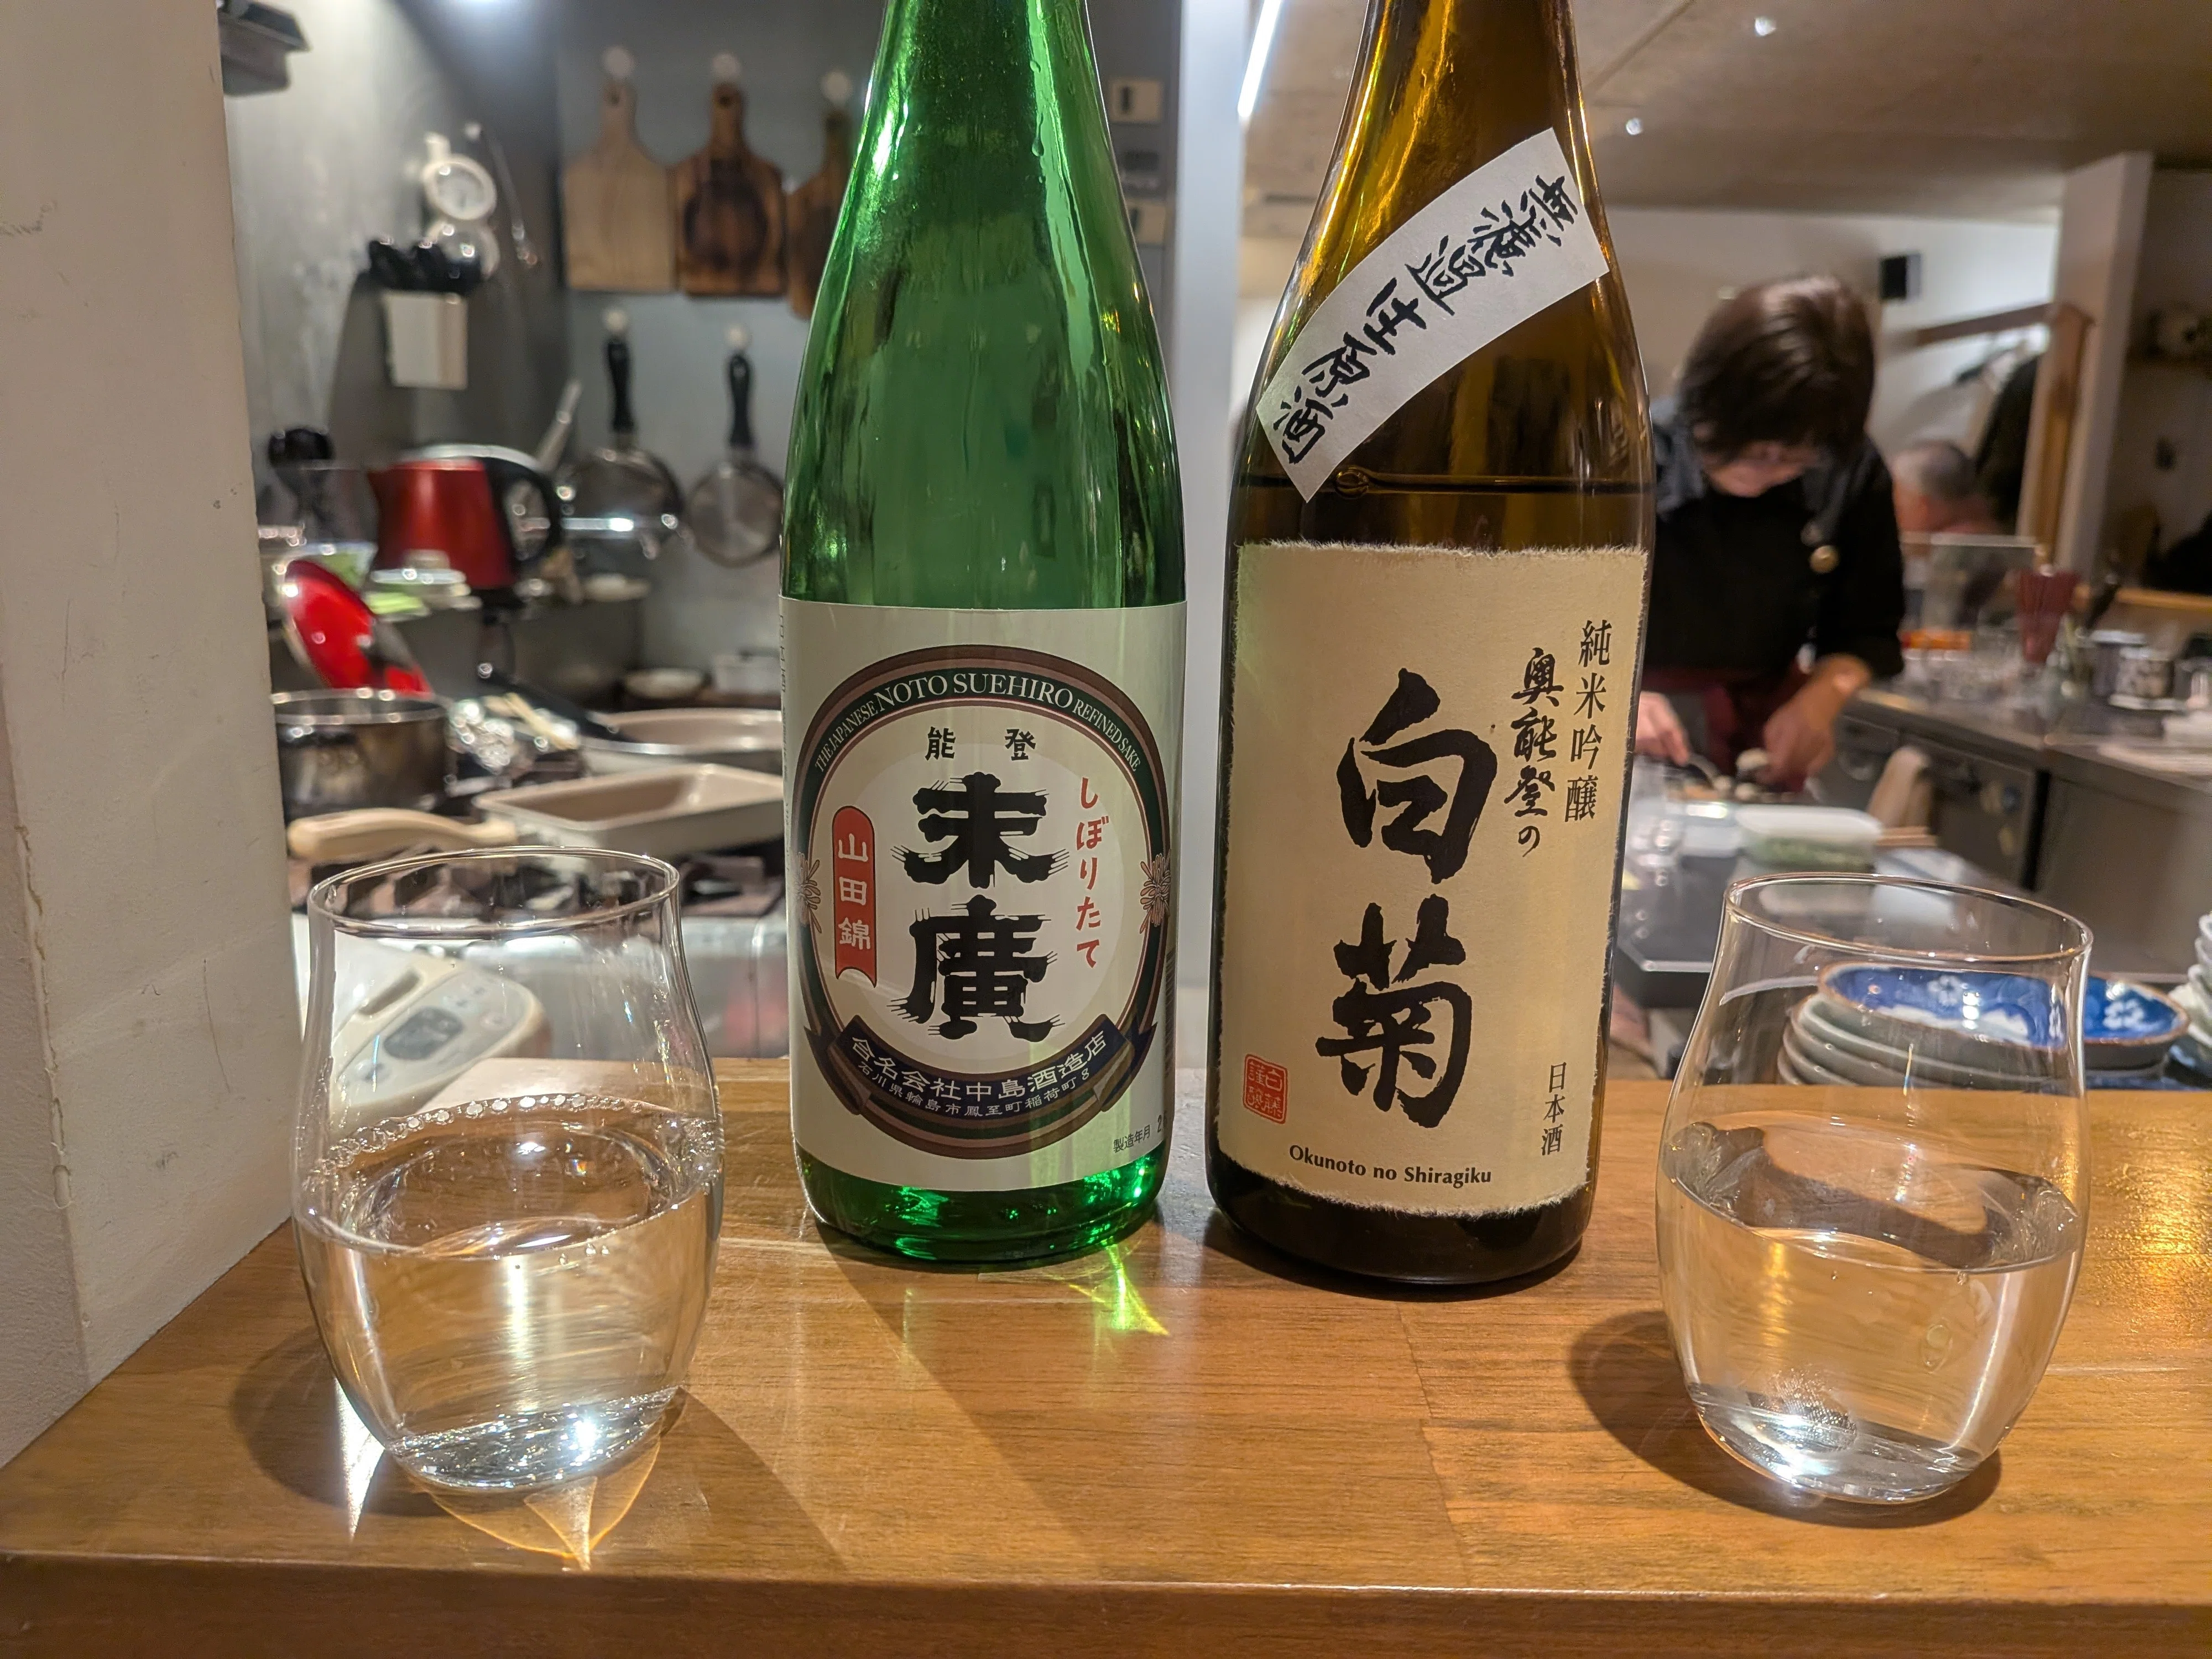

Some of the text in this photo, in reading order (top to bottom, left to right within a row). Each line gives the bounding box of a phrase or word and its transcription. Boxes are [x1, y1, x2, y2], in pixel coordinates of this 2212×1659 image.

[815, 745, 834, 773] THE
[828, 700, 879, 752] JAPANESE
[873, 675, 948, 712] NOTO
[953, 672, 1073, 709] SUEHIRO
[1072, 698, 1123, 744] REFINED
[1118, 737, 1141, 772] SAKE
[924, 726, 1036, 761] 能登
[1564, 619, 1612, 822] 純米吟醸
[838, 833, 872, 951] 山田錦
[886, 771, 1071, 1042] 末廣
[1076, 776, 1110, 969] しぼりたて
[1316, 667, 1498, 1129] 白菊
[852, 1030, 1108, 1102] 合名会社中島酒造店
[1541, 1061, 1567, 1156] 日本酒
[1113, 1124, 1150, 1153] 製造年月
[1289, 1144, 1492, 1189] Okunoto no Shiragiku
